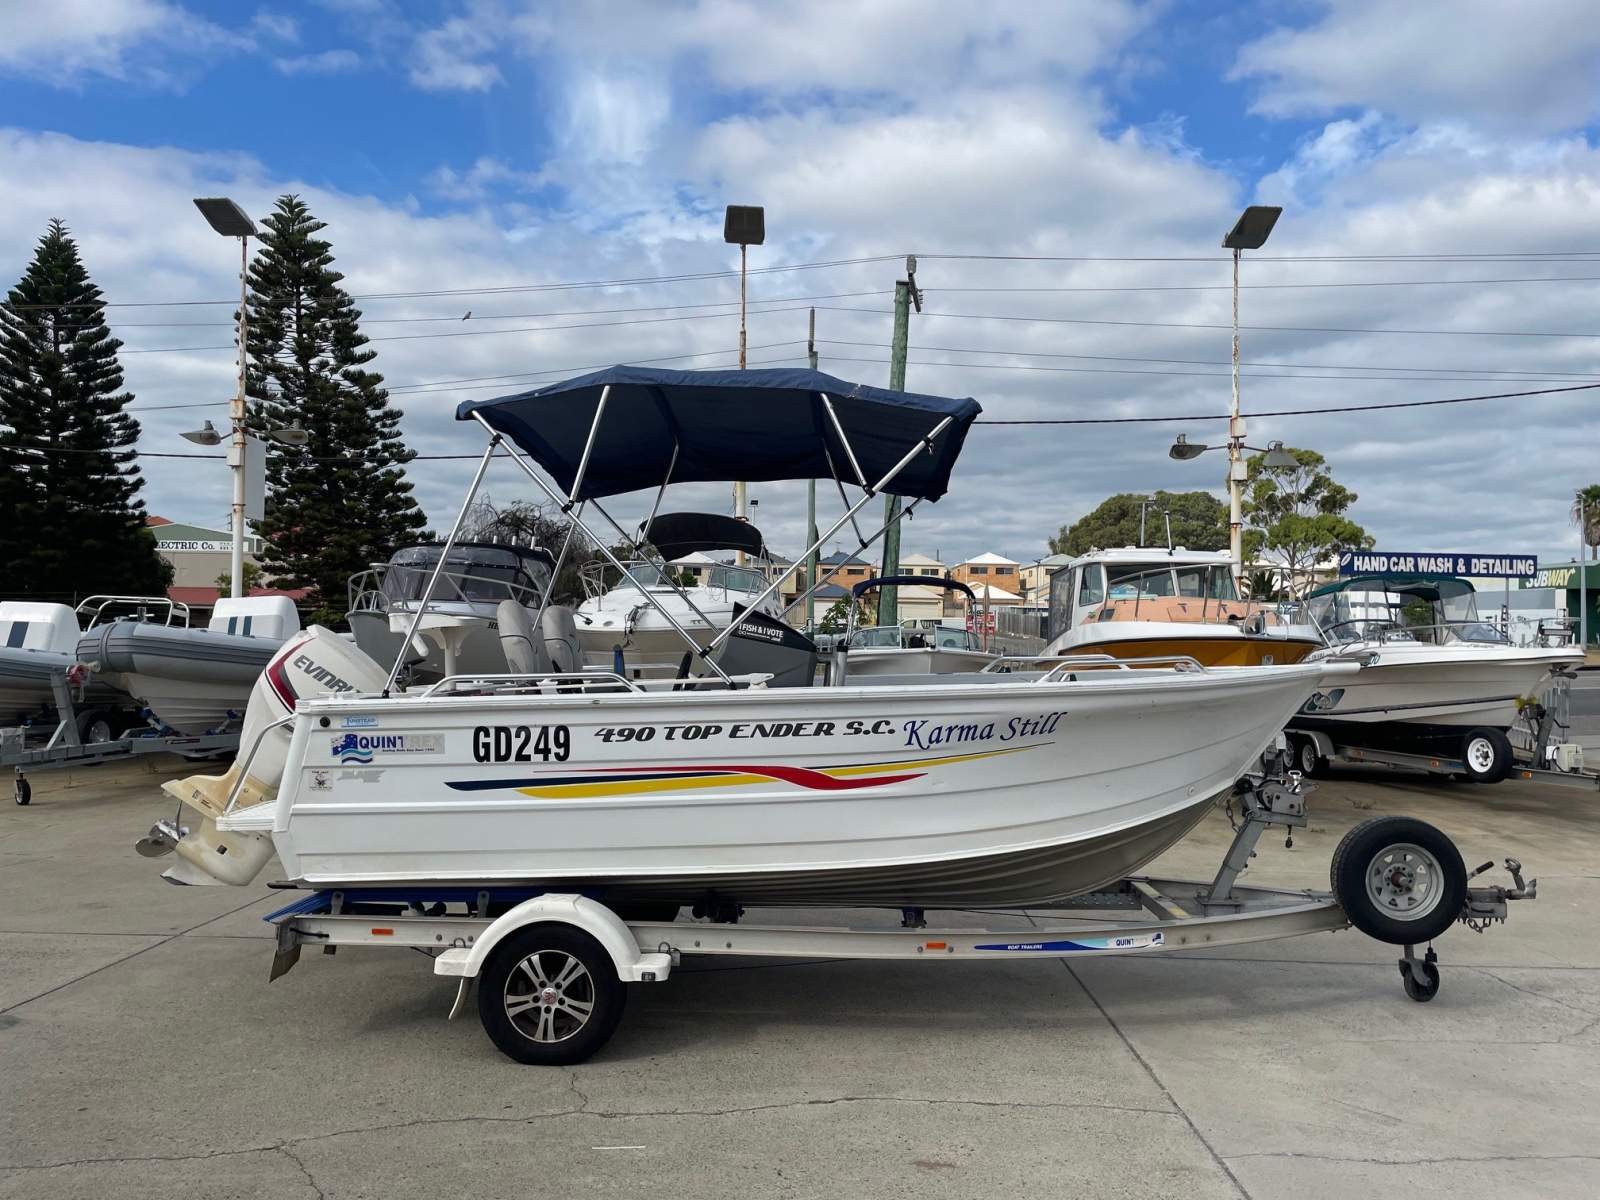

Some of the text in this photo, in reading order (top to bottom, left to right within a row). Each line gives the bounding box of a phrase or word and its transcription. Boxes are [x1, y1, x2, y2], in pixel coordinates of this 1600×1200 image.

[157, 541, 198, 550] ECTRIC
[1354, 556, 1535, 575] HAND CAR WASH & DETAILING
[743, 624, 757, 633] FISH
[767, 628, 784, 638] VOTE
[594, 716, 895, 743] 490 TOP ENDER S.C.
[904, 712, 1068, 750] Karma Still
[473, 725, 571, 763] GD249
